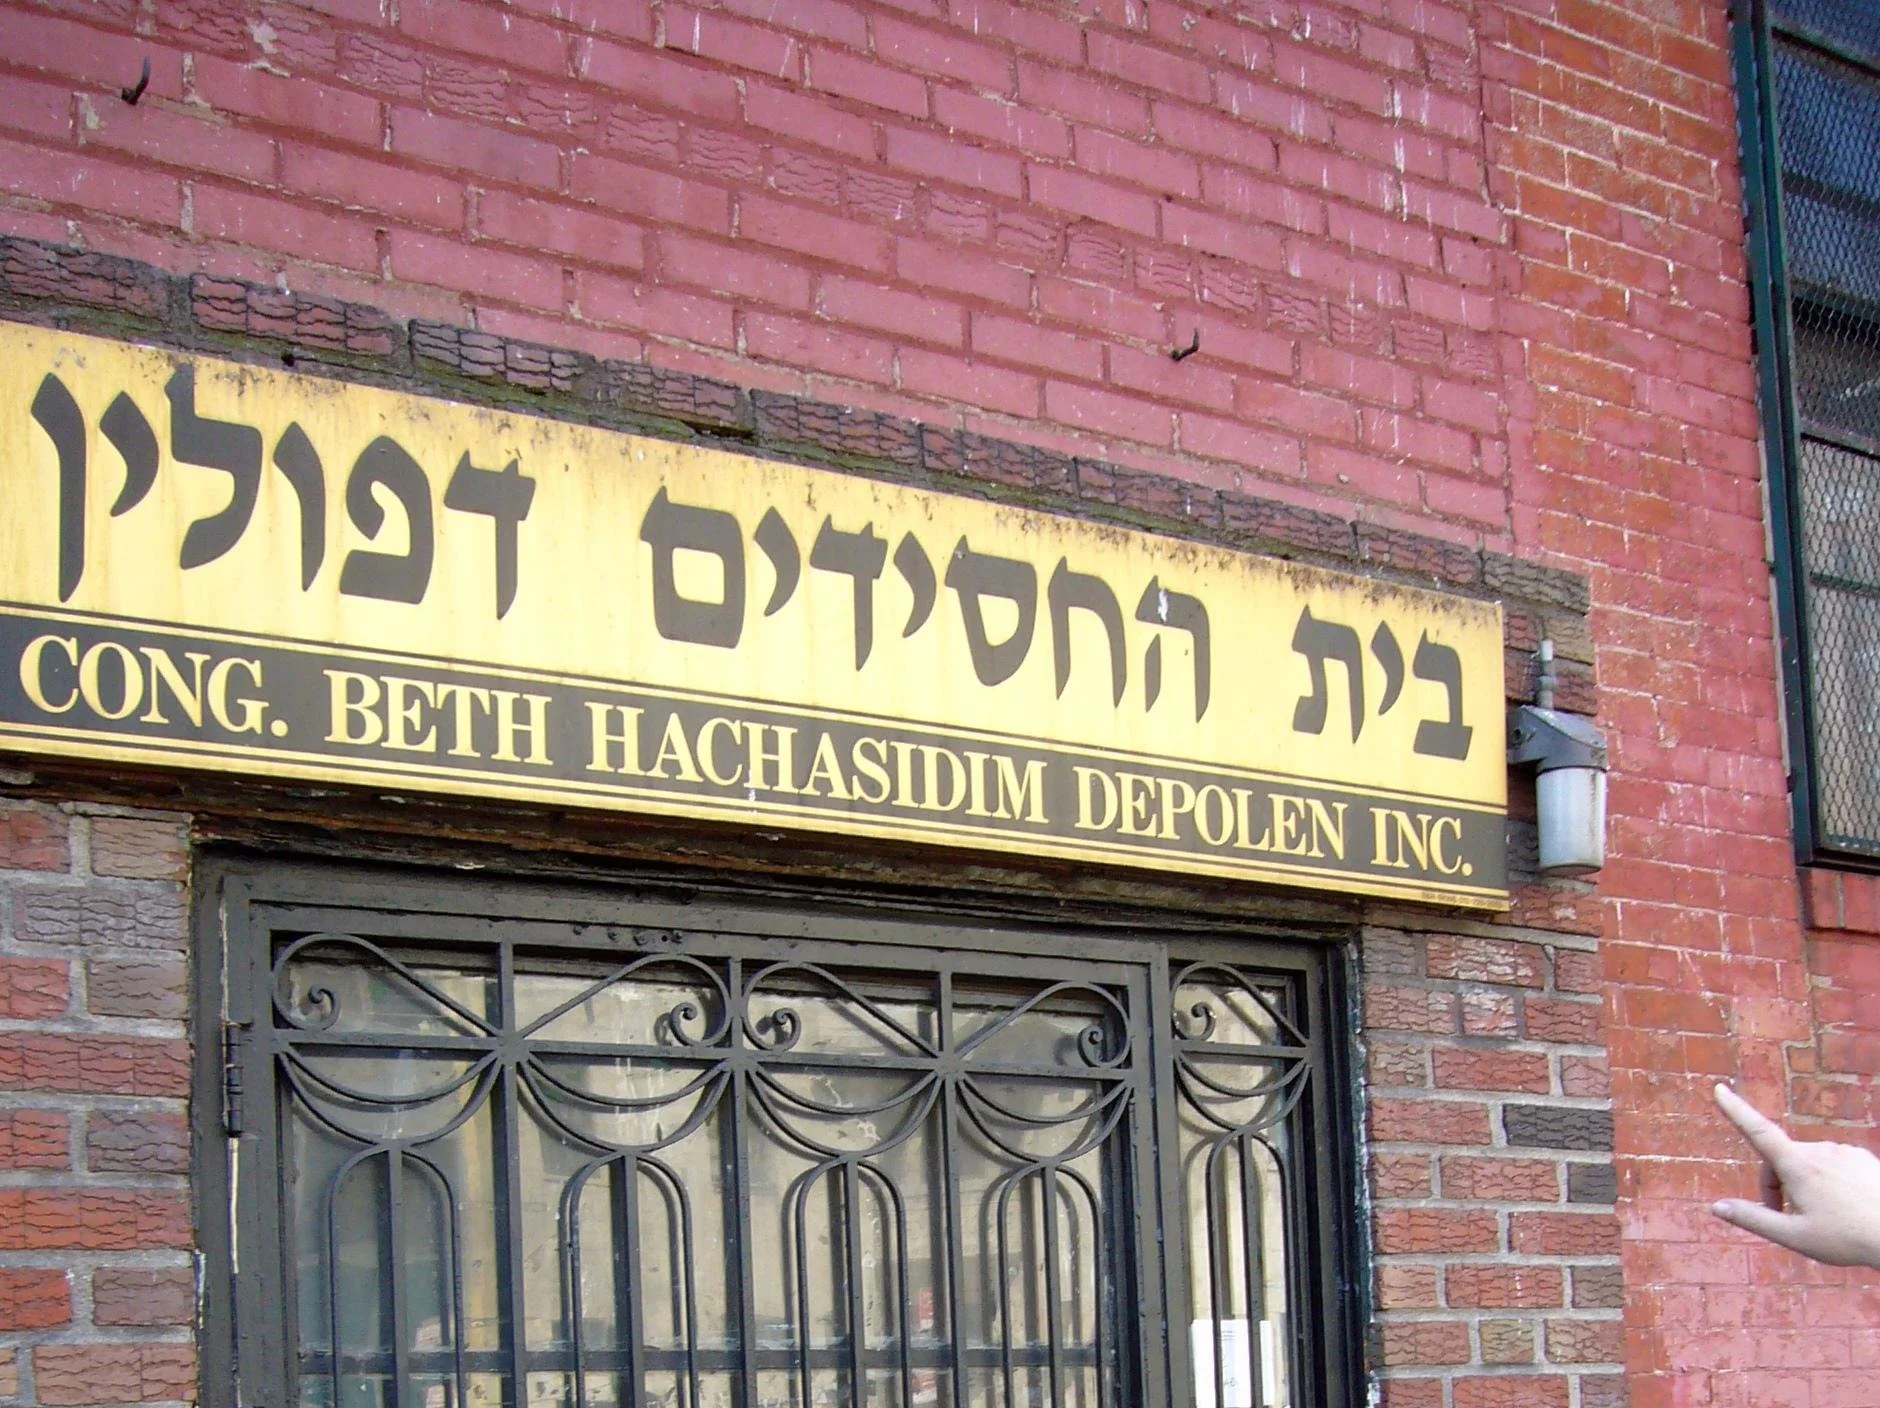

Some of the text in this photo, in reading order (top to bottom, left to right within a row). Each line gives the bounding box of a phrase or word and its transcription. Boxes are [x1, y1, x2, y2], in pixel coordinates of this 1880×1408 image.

[30, 365, 1474, 762] בית החסידים דפולין
[19, 634, 1474, 877] CONG. BETH HACHASIDIM DEPOLEN INC.
